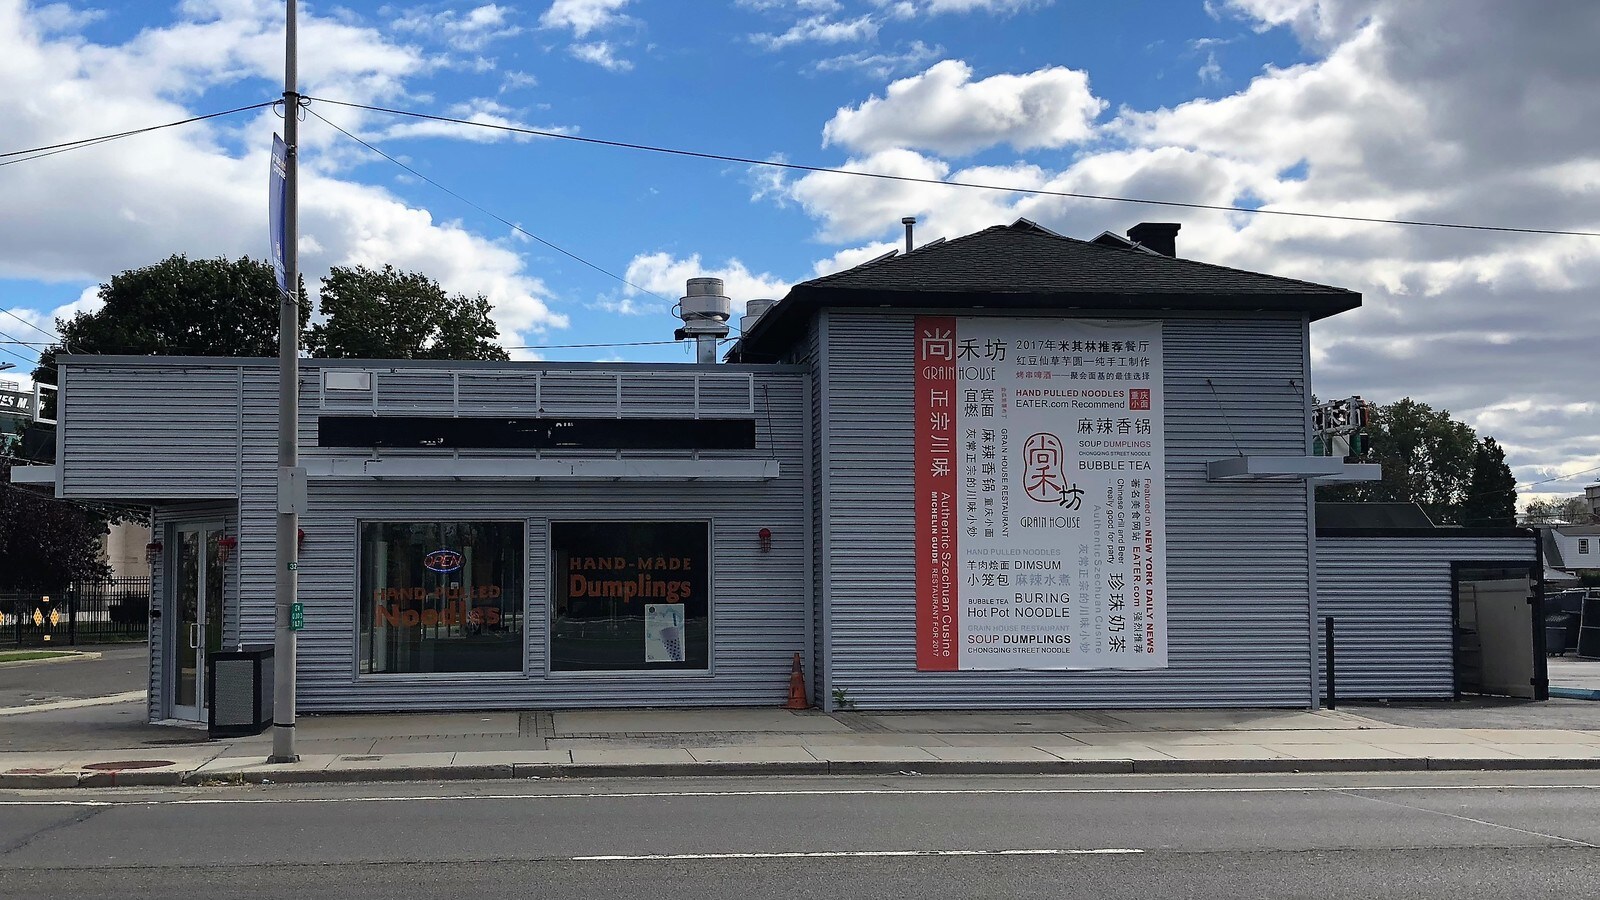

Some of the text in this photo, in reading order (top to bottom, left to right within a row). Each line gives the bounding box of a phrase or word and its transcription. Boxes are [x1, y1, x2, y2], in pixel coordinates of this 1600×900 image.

[922, 328, 1007, 361] 尚禾坊
[1016, 340, 1149, 353] 2017年米其林推荐餐厅
[922, 366, 996, 380] GRAIN HOUSE
[964, 388, 994, 403] 宜宾
[1081, 390, 1125, 398] NOODLES
[1131, 391, 1149, 400] 重庆
[17, 398, 30, 409] M.
[964, 403, 994, 418] 燃面
[1016, 400, 1125, 408] EATER.com Recommend
[1131, 400, 1149, 408] 小面
[931, 388, 950, 477] 正宗川味
[1077, 418, 1151, 434] 麻辣香锅
[982, 428, 996, 492] 麻辣香锅
[1079, 461, 1151, 470] BUBBLE TEA
[1106, 486, 1114, 507] really
[1144, 478, 1152, 514] Featured
[1020, 517, 1080, 529] GRAIN HOUSE
[1145, 517, 1150, 526] on
[424, 554, 463, 568] OPEN
[570, 557, 692, 570] HAND-MADE
[967, 560, 1061, 570] 羊肉烩面 DIMSUM
[941, 492, 952, 657] Authentic Szechuan Cusine
[968, 573, 1071, 586] 小笼包 麻辣水煮
[1094, 505, 1103, 654] Authentic Szechuan Cusine
[1133, 546, 1141, 607] EATER.com
[568, 574, 692, 603] Dumplings
[1015, 593, 1070, 603] BURING
[374, 600, 501, 628] Noodles
[967, 607, 1070, 618] Hot Pot NOODLE
[1108, 573, 1126, 652] 珍珠奶茶
[968, 635, 1071, 644] SOUP DUMPLINGS
[1146, 624, 1154, 654] NEWS
